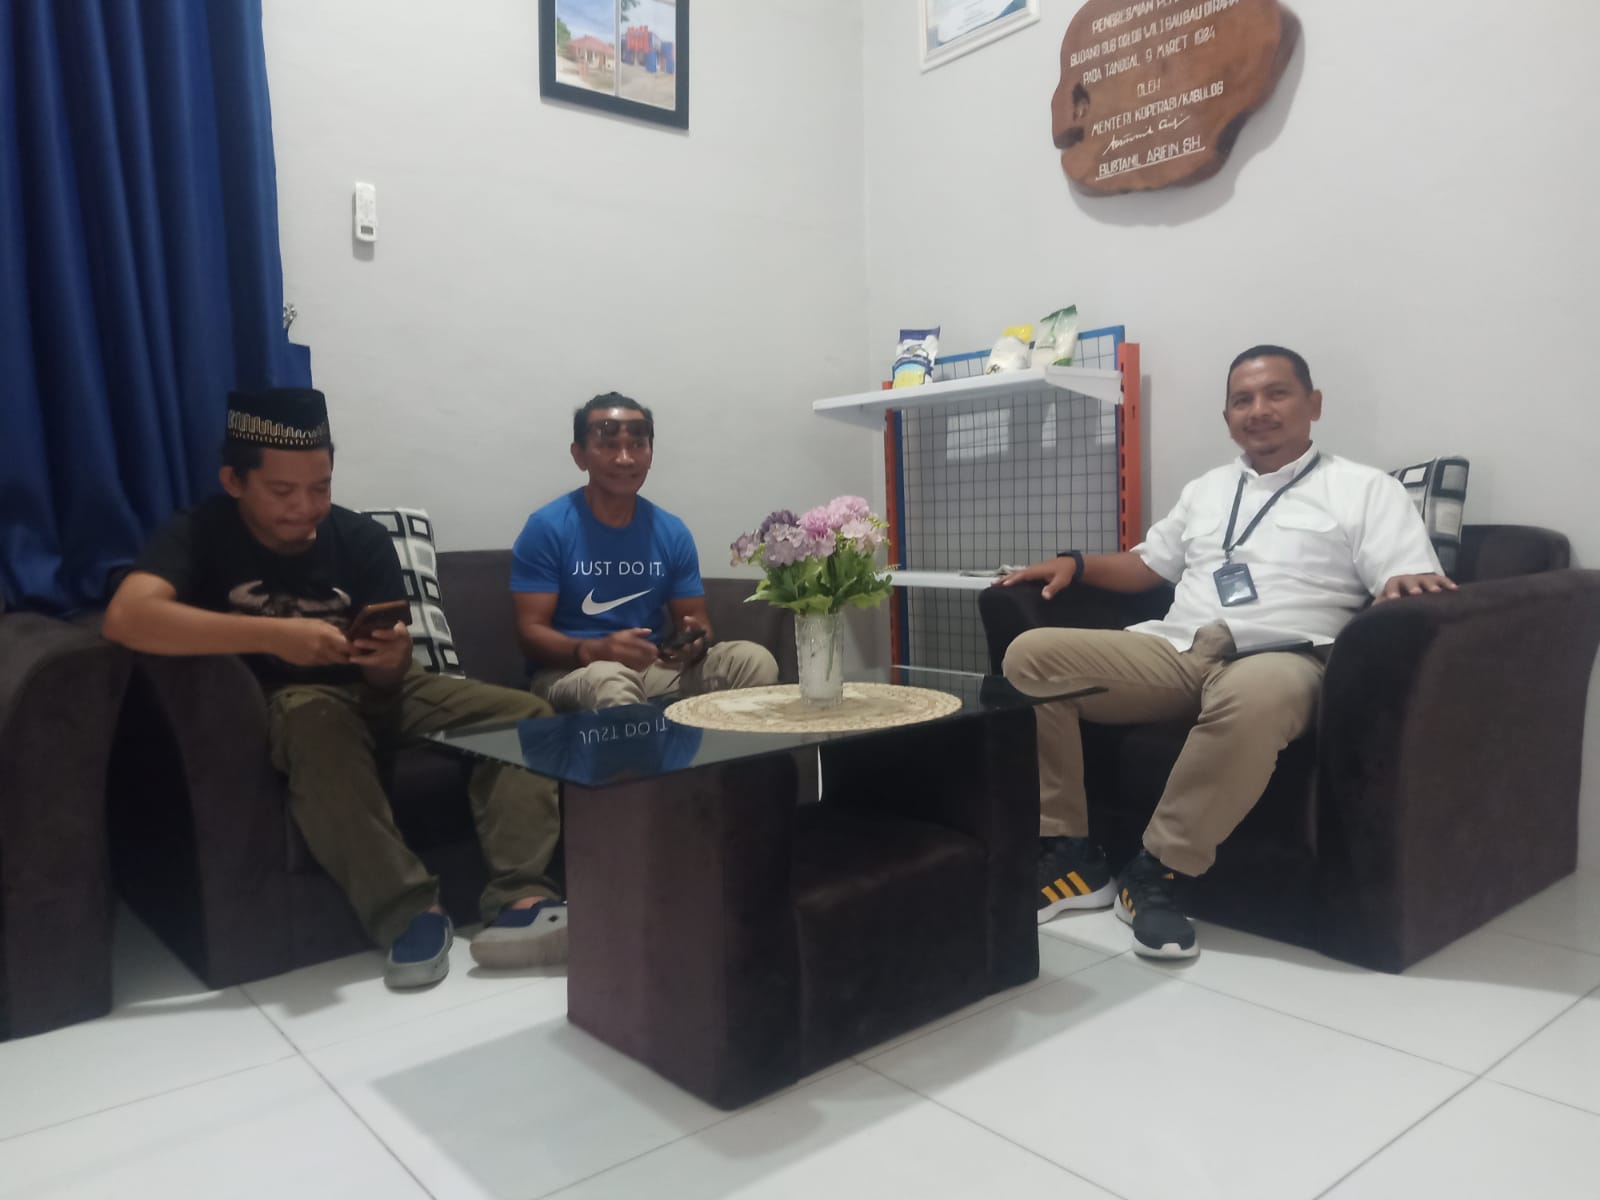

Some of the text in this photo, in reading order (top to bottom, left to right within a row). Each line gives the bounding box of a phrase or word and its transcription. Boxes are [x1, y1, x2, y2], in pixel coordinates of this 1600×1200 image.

[1083, 67, 1102, 86] PADA
[1105, 53, 1140, 77] TANGGAL
[1145, 48, 1152, 63] 9
[1157, 34, 1188, 58] MARET
[1137, 77, 1161, 97] OLEH
[1091, 111, 1132, 136] MENTERI
[1146, 141, 1180, 163] ARIFIN
[1183, 135, 1201, 154] SH
[572, 561, 665, 577] JUST DO IT.
